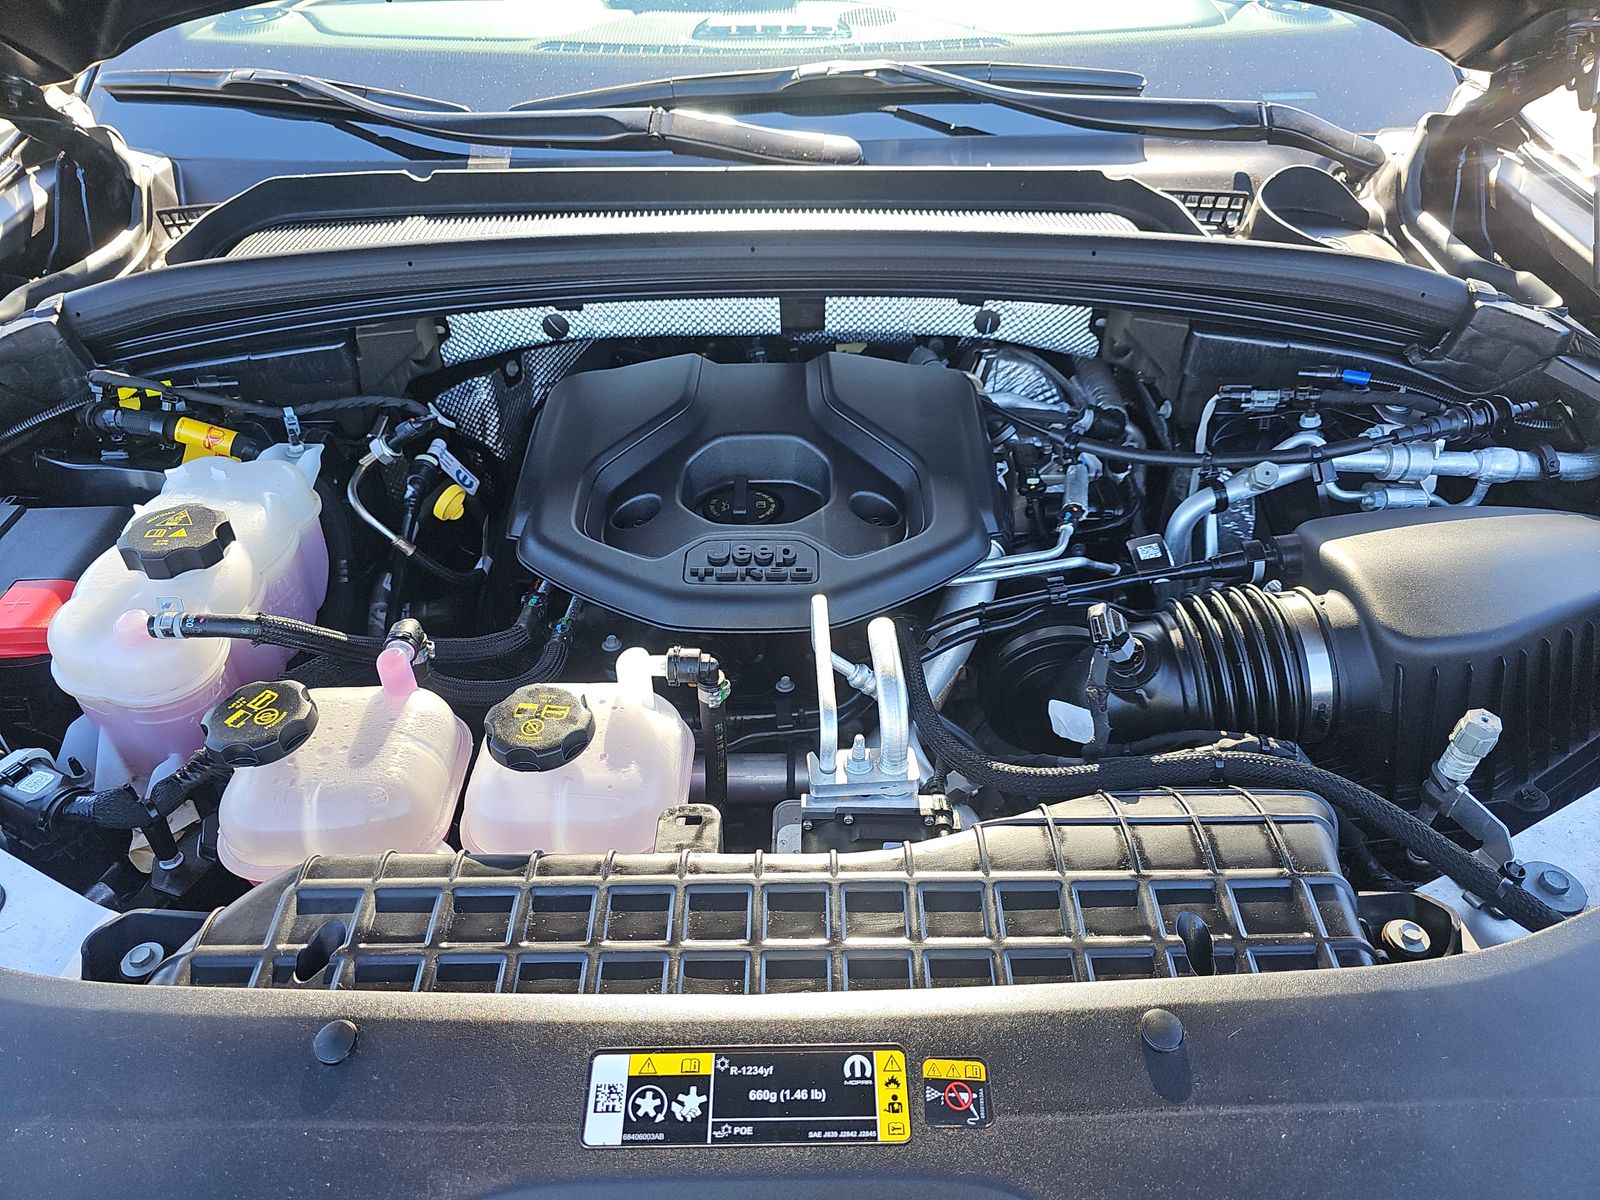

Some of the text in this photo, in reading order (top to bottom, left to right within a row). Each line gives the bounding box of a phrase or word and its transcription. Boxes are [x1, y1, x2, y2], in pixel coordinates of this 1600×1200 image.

[707, 541, 797, 567] Jeep
[690, 567, 813, 581] TURBO
[730, 1066, 774, 1077] R-1234yf
[748, 1089, 827, 1102] 660g (1.46 lb)
[622, 1133, 665, 1141] 68406003AB
[733, 1126, 754, 1136] POE
